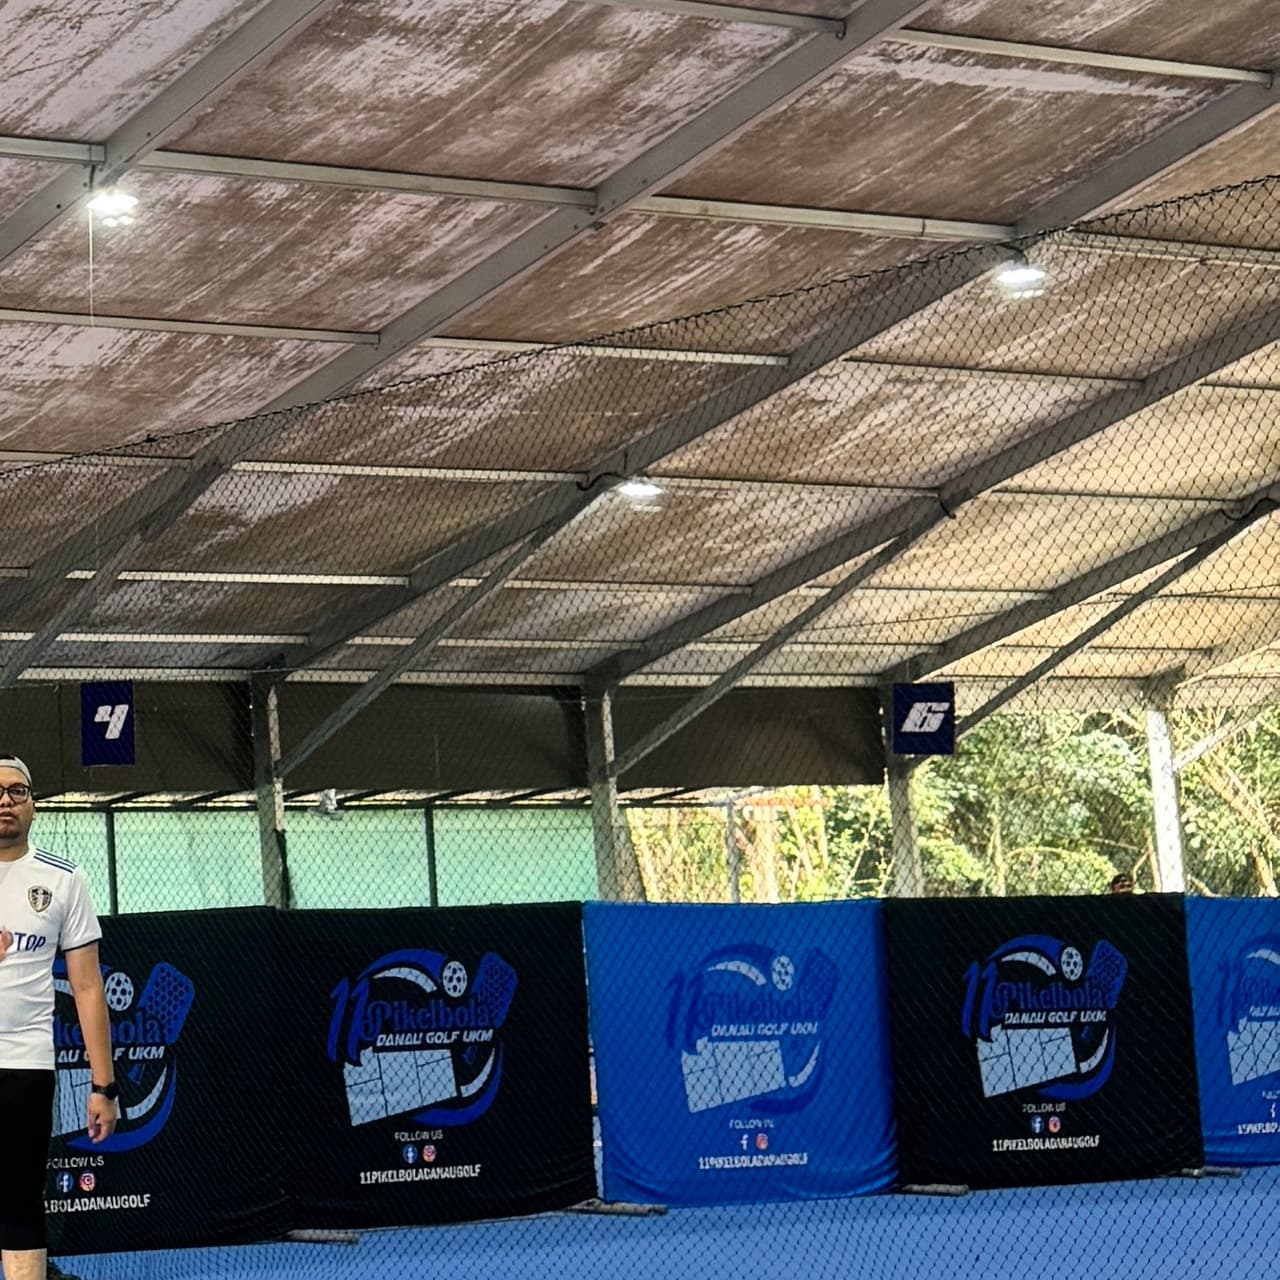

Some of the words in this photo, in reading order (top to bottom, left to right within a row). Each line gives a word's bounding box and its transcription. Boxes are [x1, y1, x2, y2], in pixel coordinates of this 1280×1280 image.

[94, 704, 129, 739] 4
[1048, 1011, 1077, 1023] GOLF
[426, 1031, 460, 1044] GOLF
[462, 1029, 494, 1042] UKM
[128, 1045, 166, 1060] UKM
[89, 1155, 105, 1167] US
